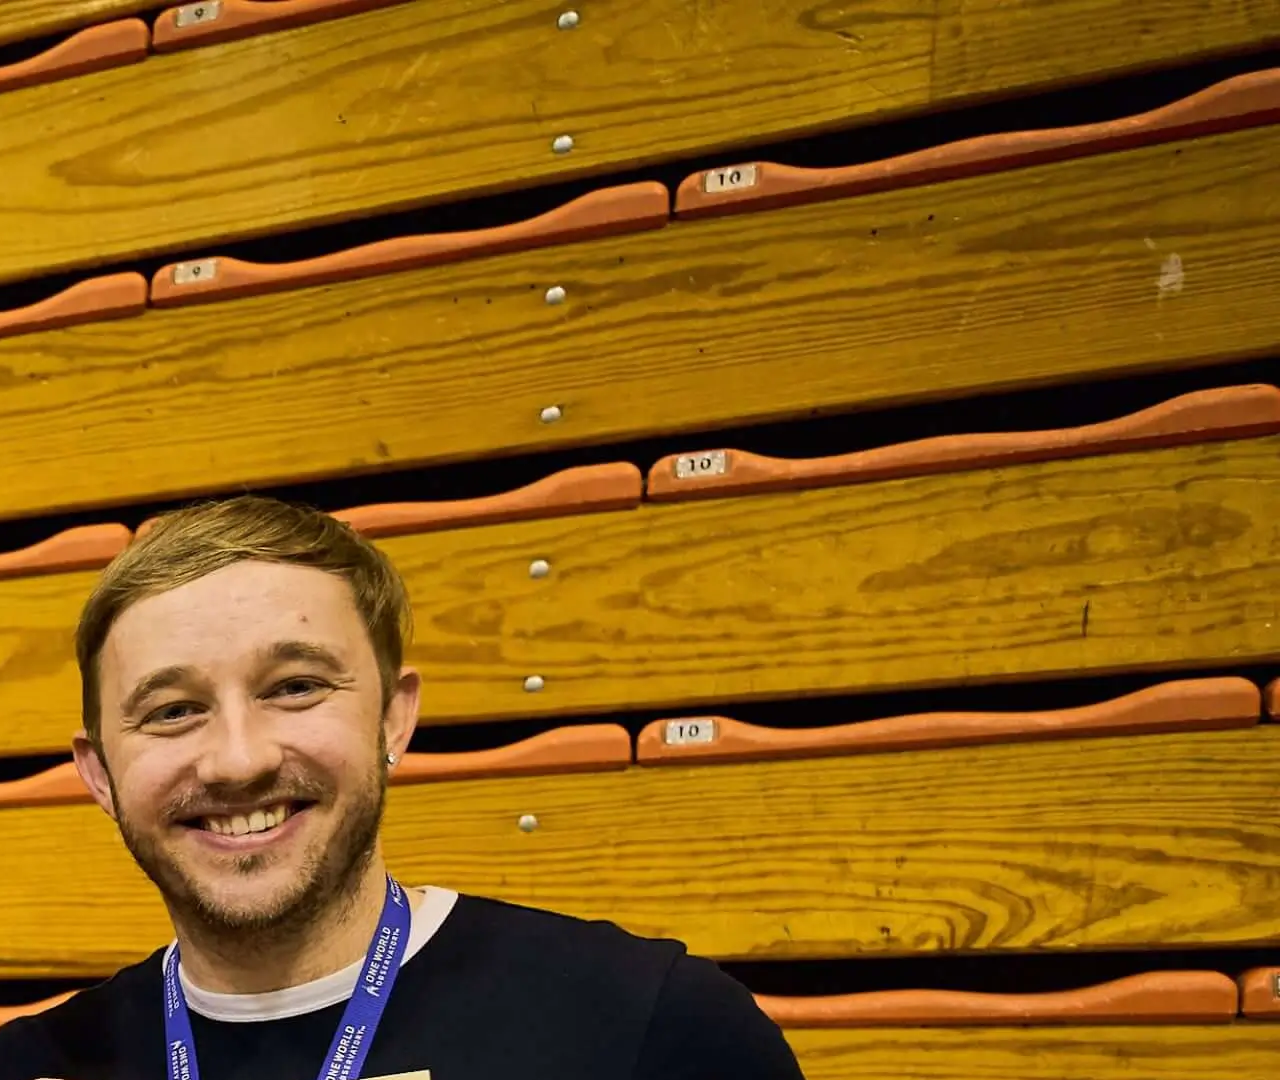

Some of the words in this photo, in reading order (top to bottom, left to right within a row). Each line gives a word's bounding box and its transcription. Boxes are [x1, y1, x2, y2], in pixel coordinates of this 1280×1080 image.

[718, 170, 741, 187] 10
[689, 456, 712, 472] 10
[678, 724, 700, 739] 10
